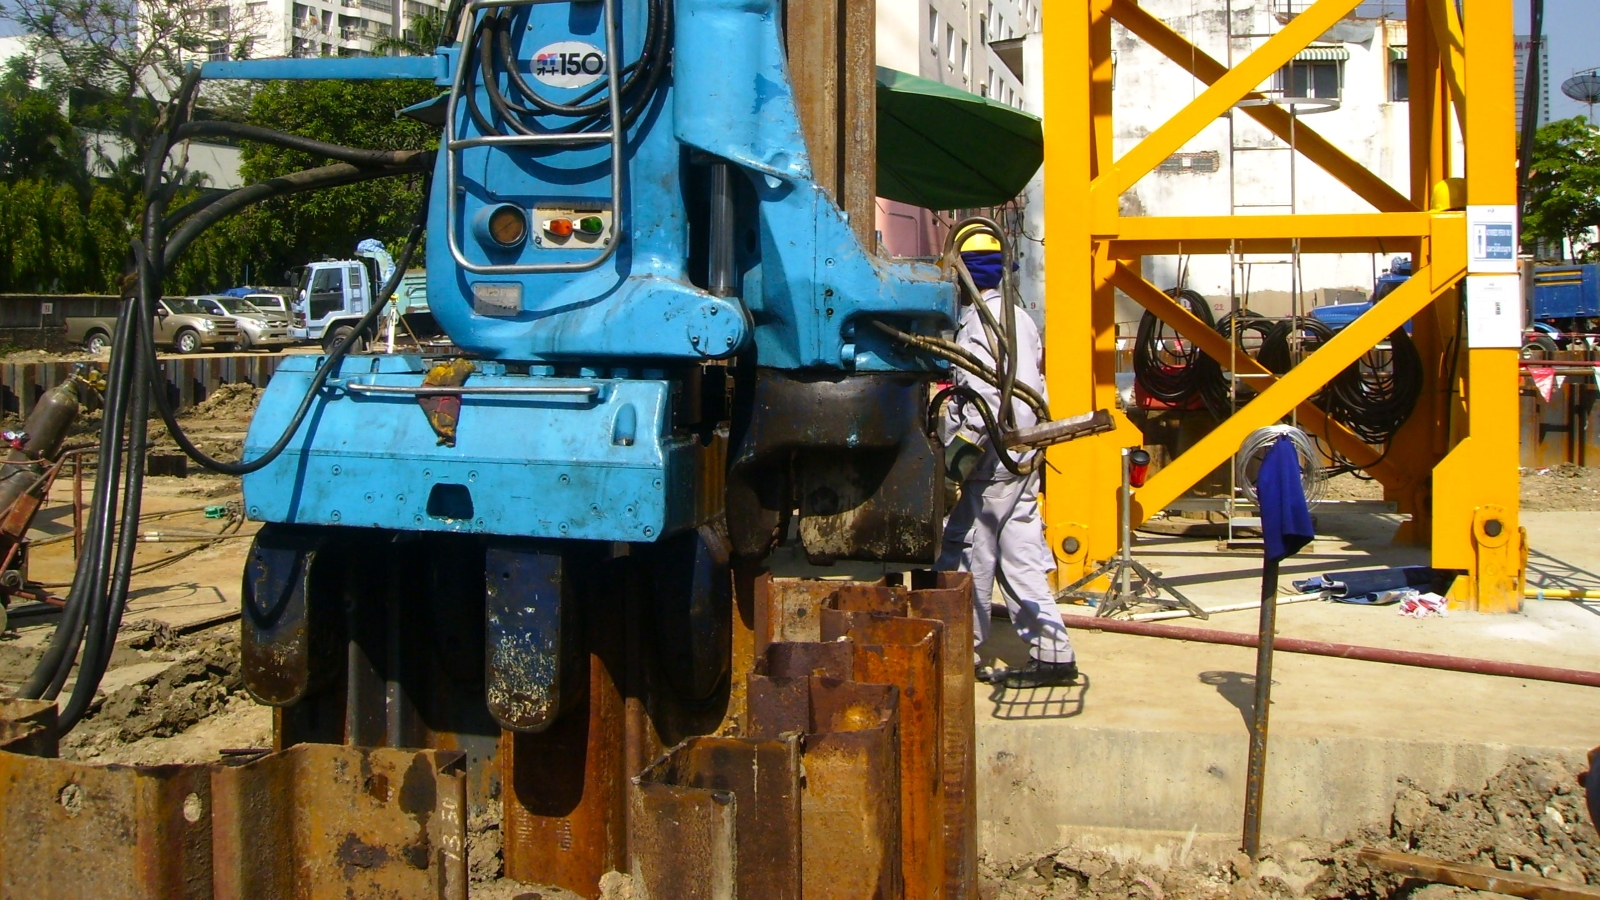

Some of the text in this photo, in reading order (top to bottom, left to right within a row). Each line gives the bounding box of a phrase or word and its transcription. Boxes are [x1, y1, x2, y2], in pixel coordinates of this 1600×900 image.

[537, 66, 559, 76] オート
[559, 52, 603, 76] 150
